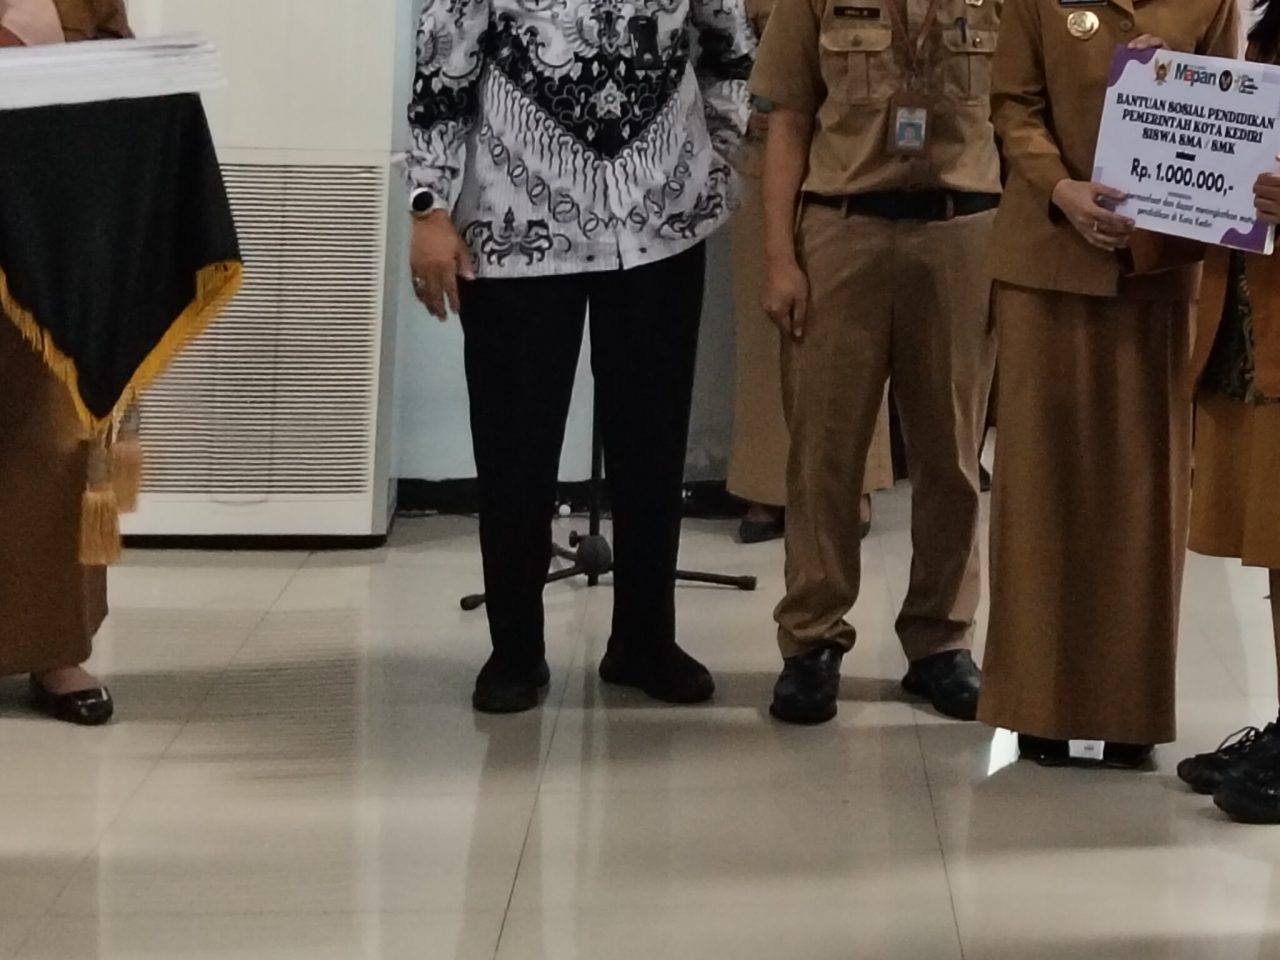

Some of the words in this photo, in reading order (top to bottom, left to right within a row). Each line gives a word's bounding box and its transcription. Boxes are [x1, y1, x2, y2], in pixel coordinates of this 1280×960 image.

[1174, 63, 1217, 86] Mapan
[1116, 92, 1167, 111] BANTUAN
[1167, 101, 1206, 119] SOSIAL
[1207, 107, 1276, 129] PENDIDIKAN
[1122, 109, 1192, 131] PEMERINTAH
[1193, 121, 1223, 137] KOTA
[1224, 126, 1264, 143] KEDIRI
[1142, 127, 1177, 144] SISWA
[1178, 133, 1203, 149] SMA
[1210, 139, 1236, 155] SMK
[1130, 157, 1151, 183] Rp.
[1156, 162, 1234, 197] 1.000.000,-
